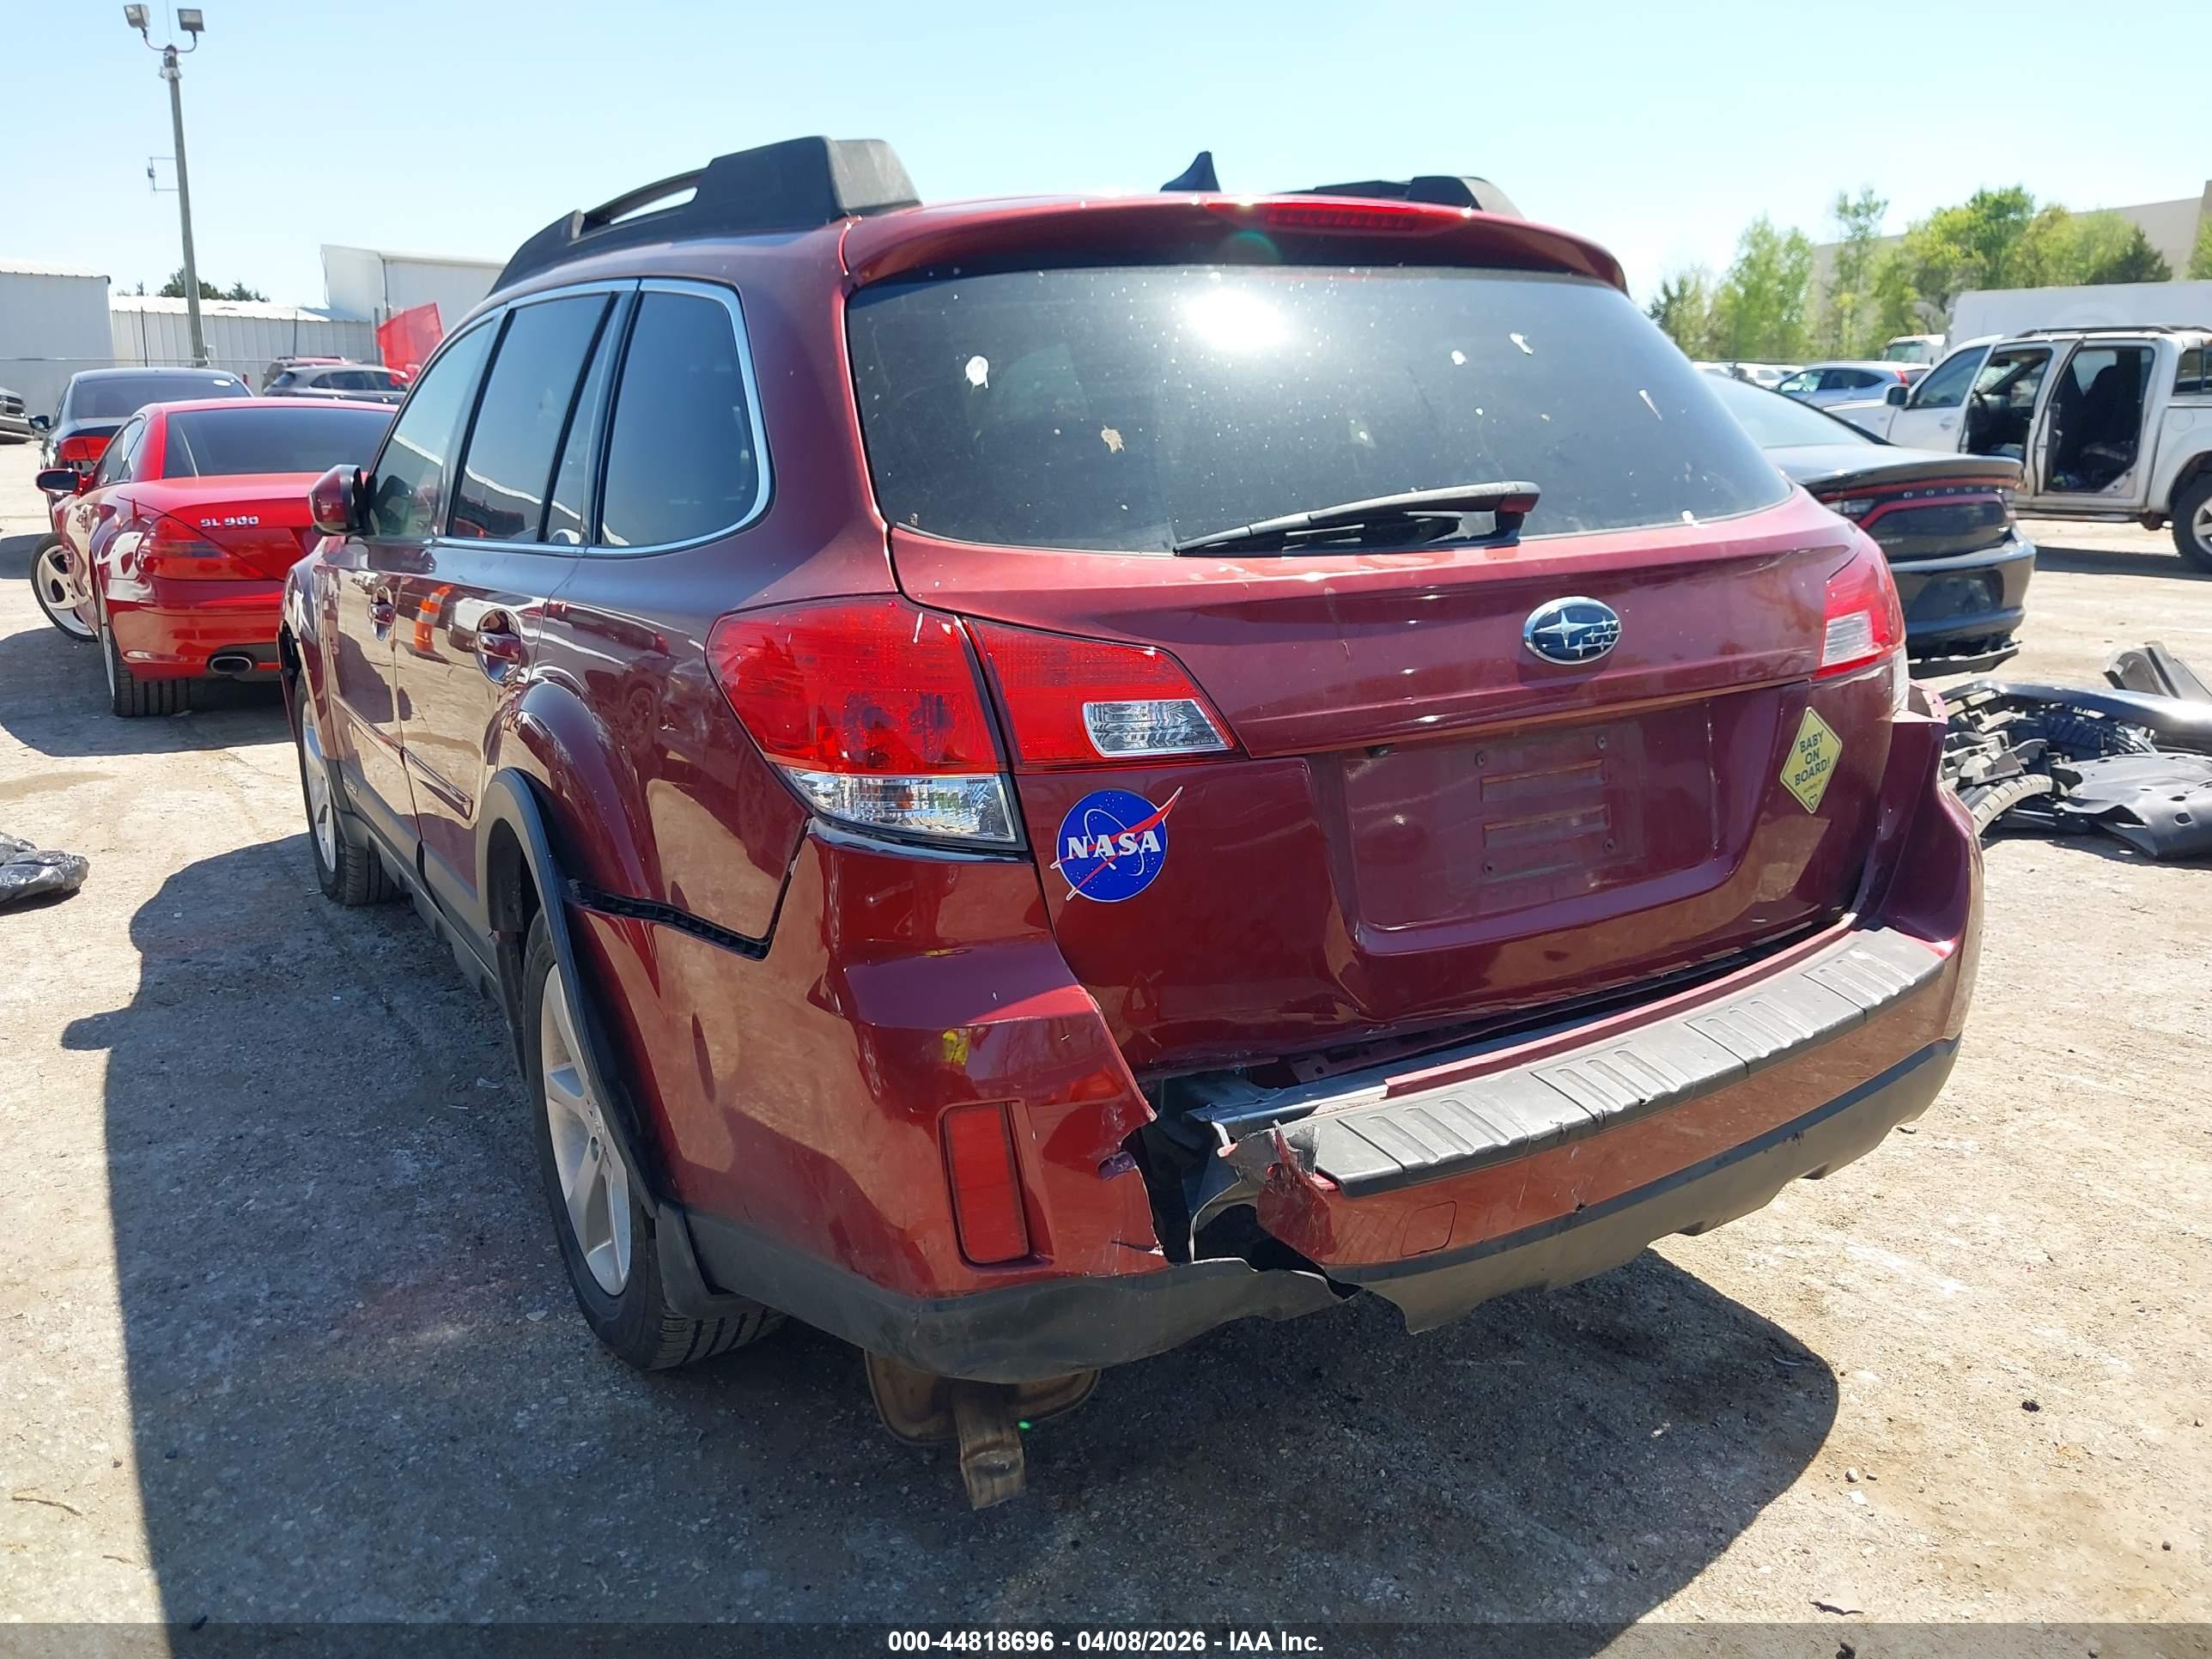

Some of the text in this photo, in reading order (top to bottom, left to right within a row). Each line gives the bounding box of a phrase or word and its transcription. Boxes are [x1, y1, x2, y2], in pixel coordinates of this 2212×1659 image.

[200, 518, 222, 527] SL
[1799, 730, 1825, 753] BABY
[1805, 748, 1820, 765] ON
[1794, 757, 1831, 787] BOARD!
[1066, 830, 1162, 860] NASA
